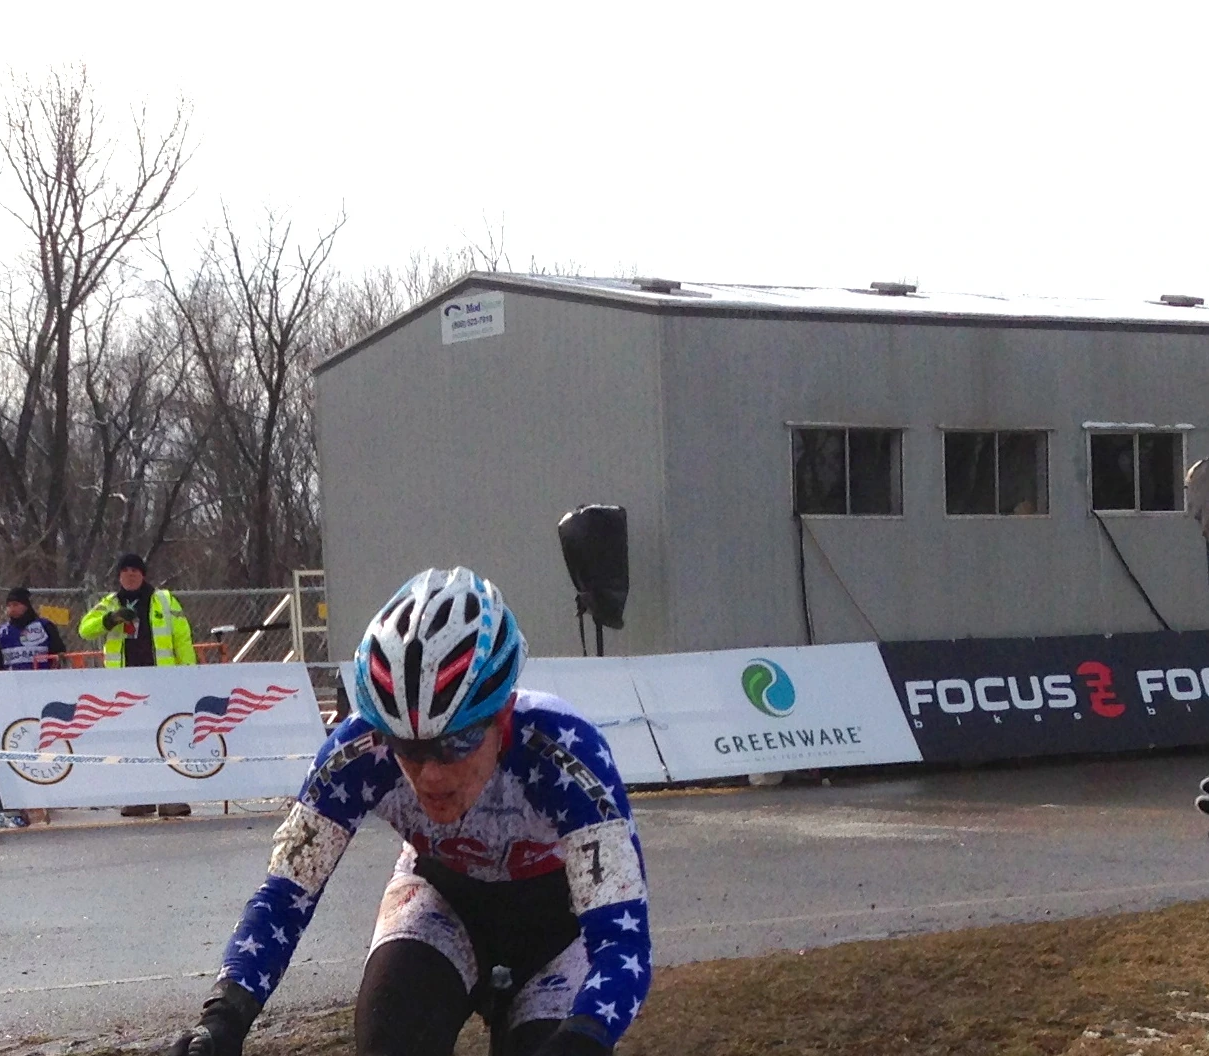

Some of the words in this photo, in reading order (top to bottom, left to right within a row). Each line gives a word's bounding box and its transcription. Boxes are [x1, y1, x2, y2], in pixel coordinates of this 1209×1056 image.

[905, 674, 1077, 716] FOCUS
[1136, 668, 1209, 704] FO
[163, 720, 184, 745] USA
[713, 725, 862, 755] GREENWARE
